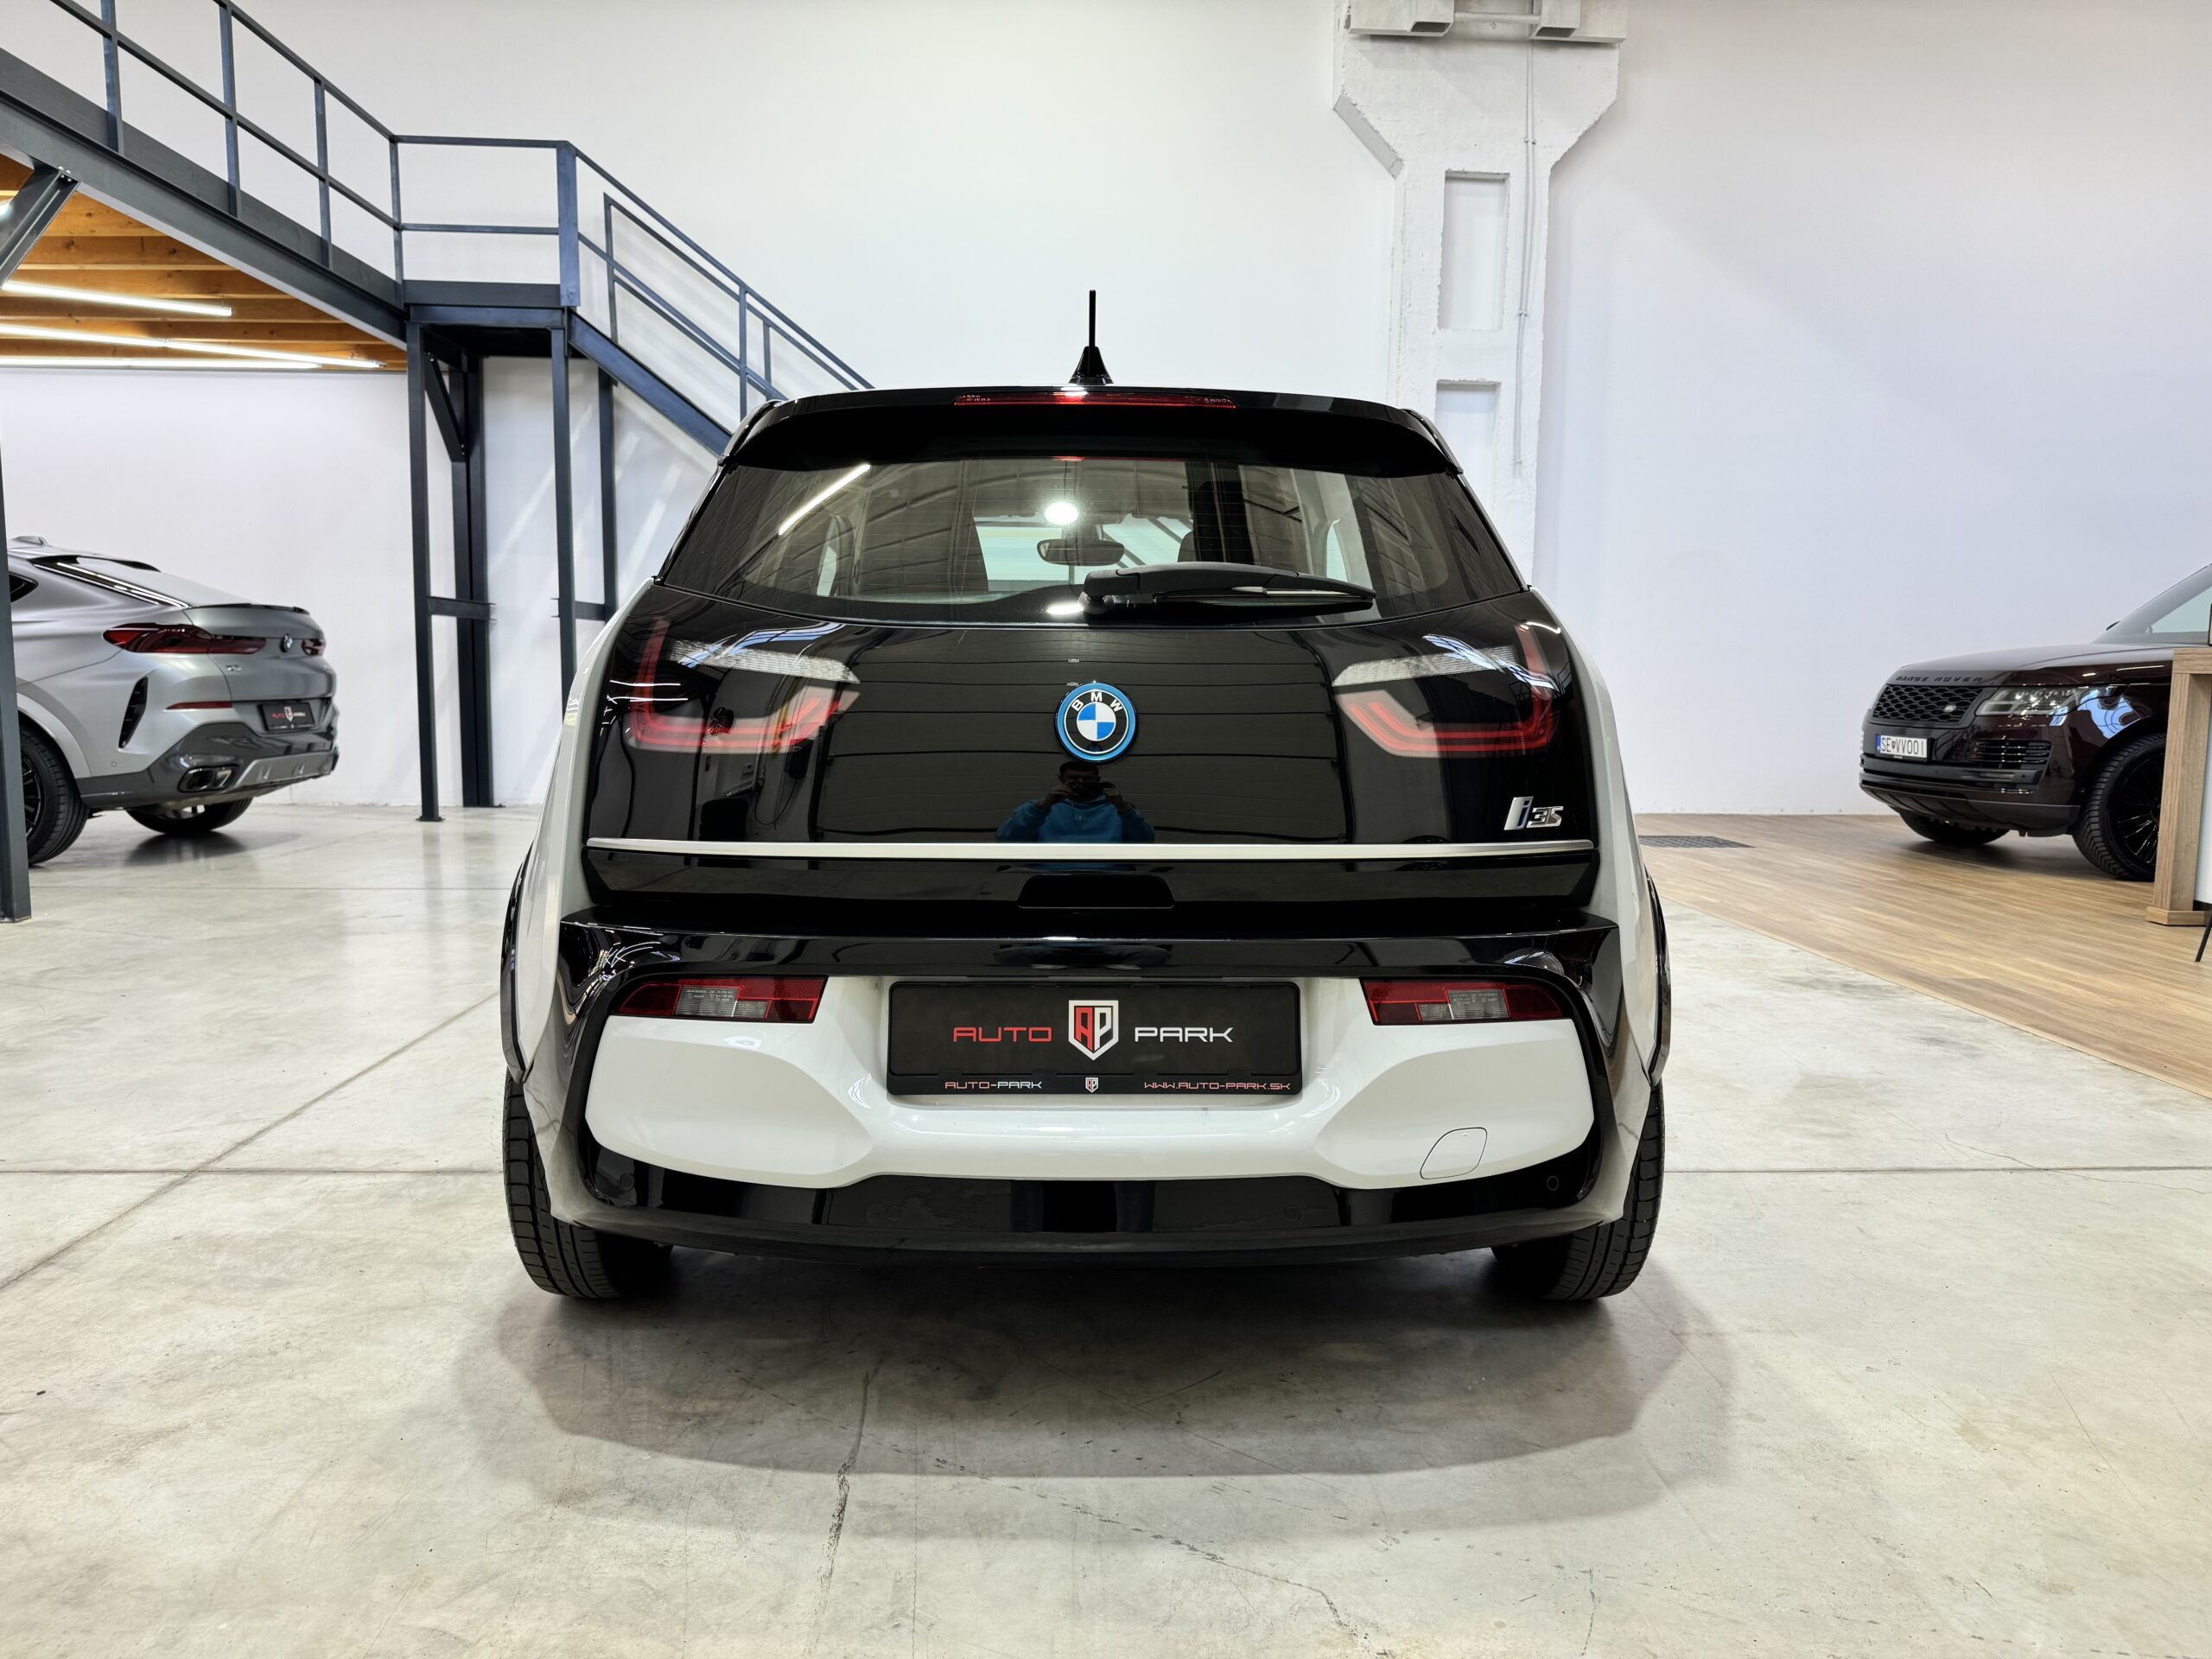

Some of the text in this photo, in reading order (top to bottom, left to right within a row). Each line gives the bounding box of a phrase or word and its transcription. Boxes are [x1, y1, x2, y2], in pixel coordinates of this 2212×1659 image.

[1071, 692, 1122, 712] BMW
[953, 1007, 1234, 1052] AUTO AP PARK
[944, 1081, 1043, 1090] AUTO-PARK
[1143, 1082, 1291, 1090] WWW.AUTO-PARK.SK
